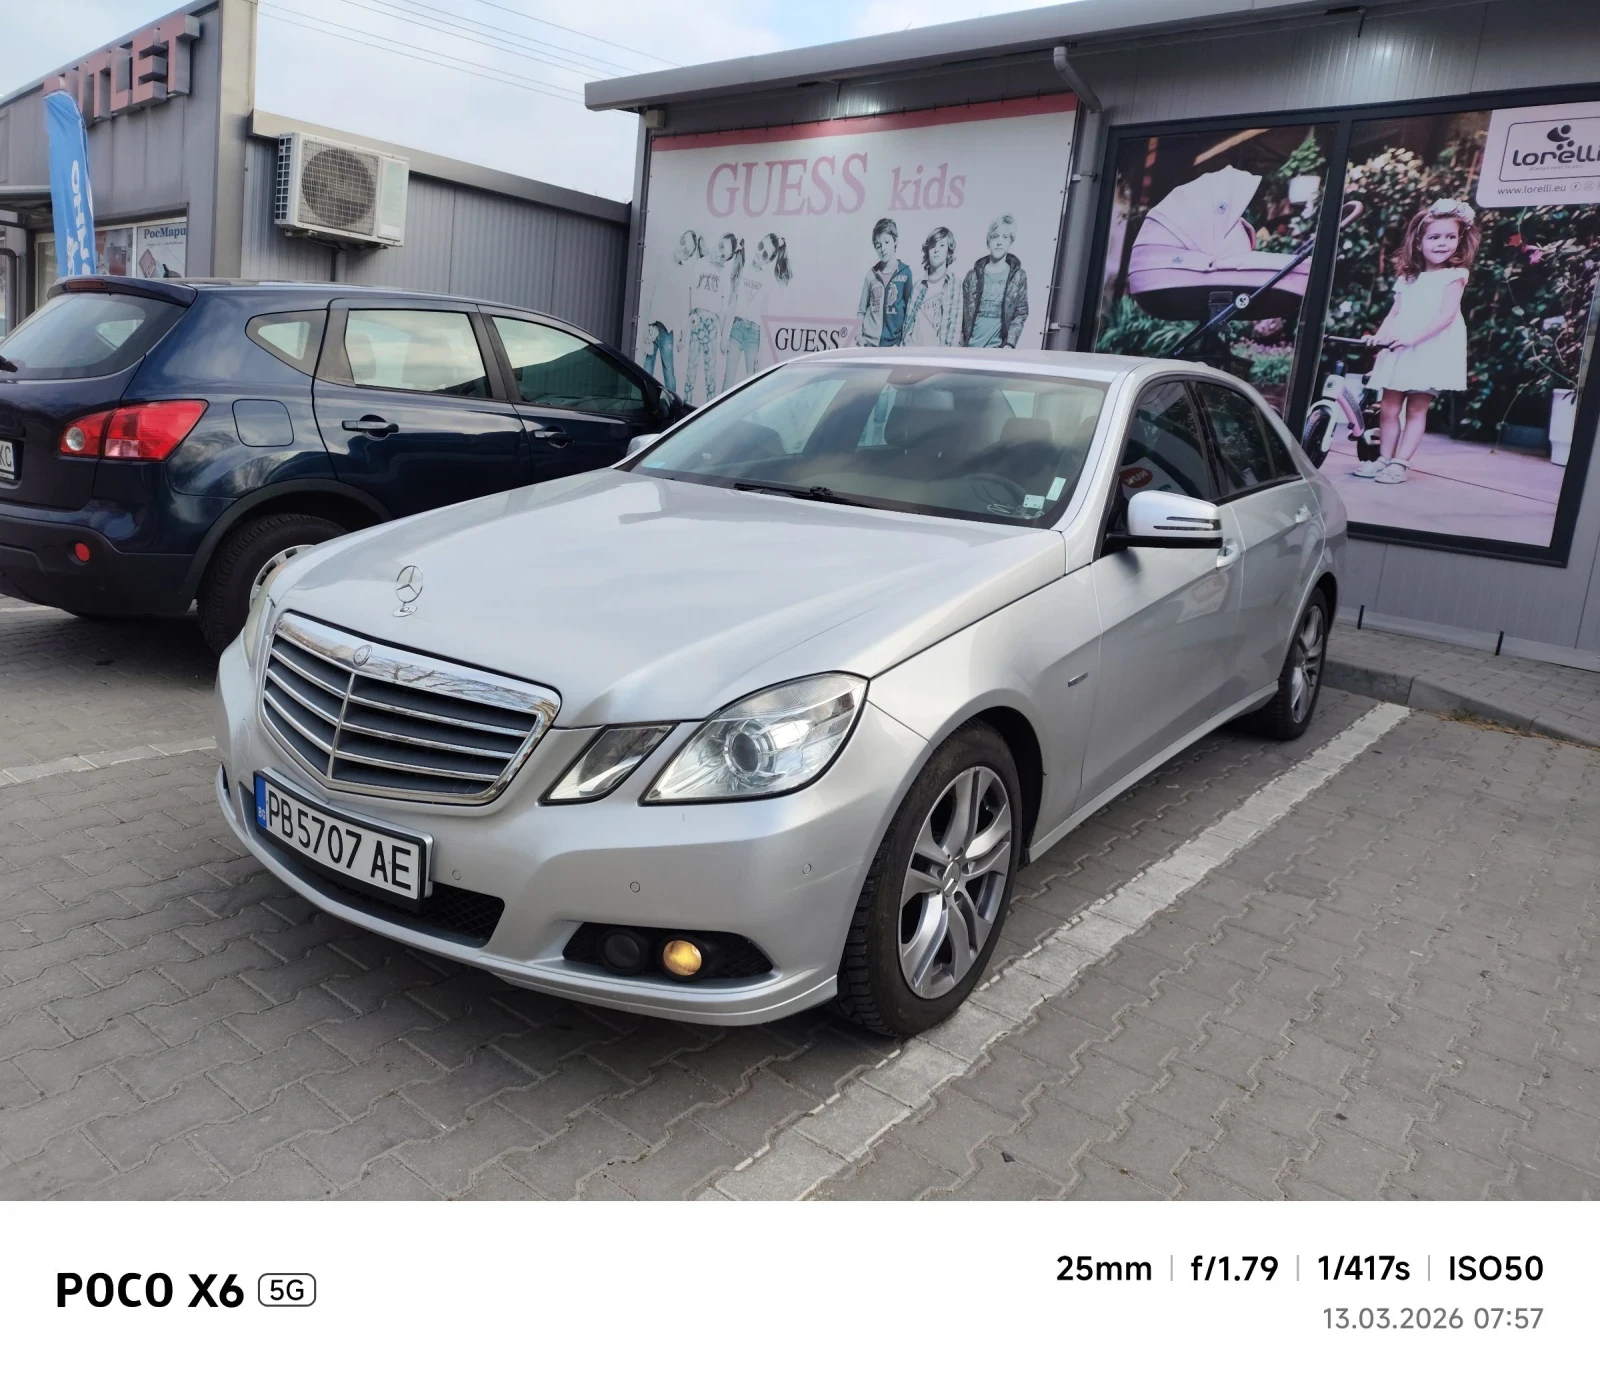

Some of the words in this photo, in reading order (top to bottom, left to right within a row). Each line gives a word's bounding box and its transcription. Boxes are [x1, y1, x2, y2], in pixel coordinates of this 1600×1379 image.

[706, 152, 868, 218] GUESS
[887, 162, 966, 212] kids
[1497, 184, 1566, 195] www.lorelli.eu
[258, 806, 266, 820] BG
[268, 789, 294, 838] PB
[297, 807, 362, 869] 5707
[370, 840, 412, 891] AE
